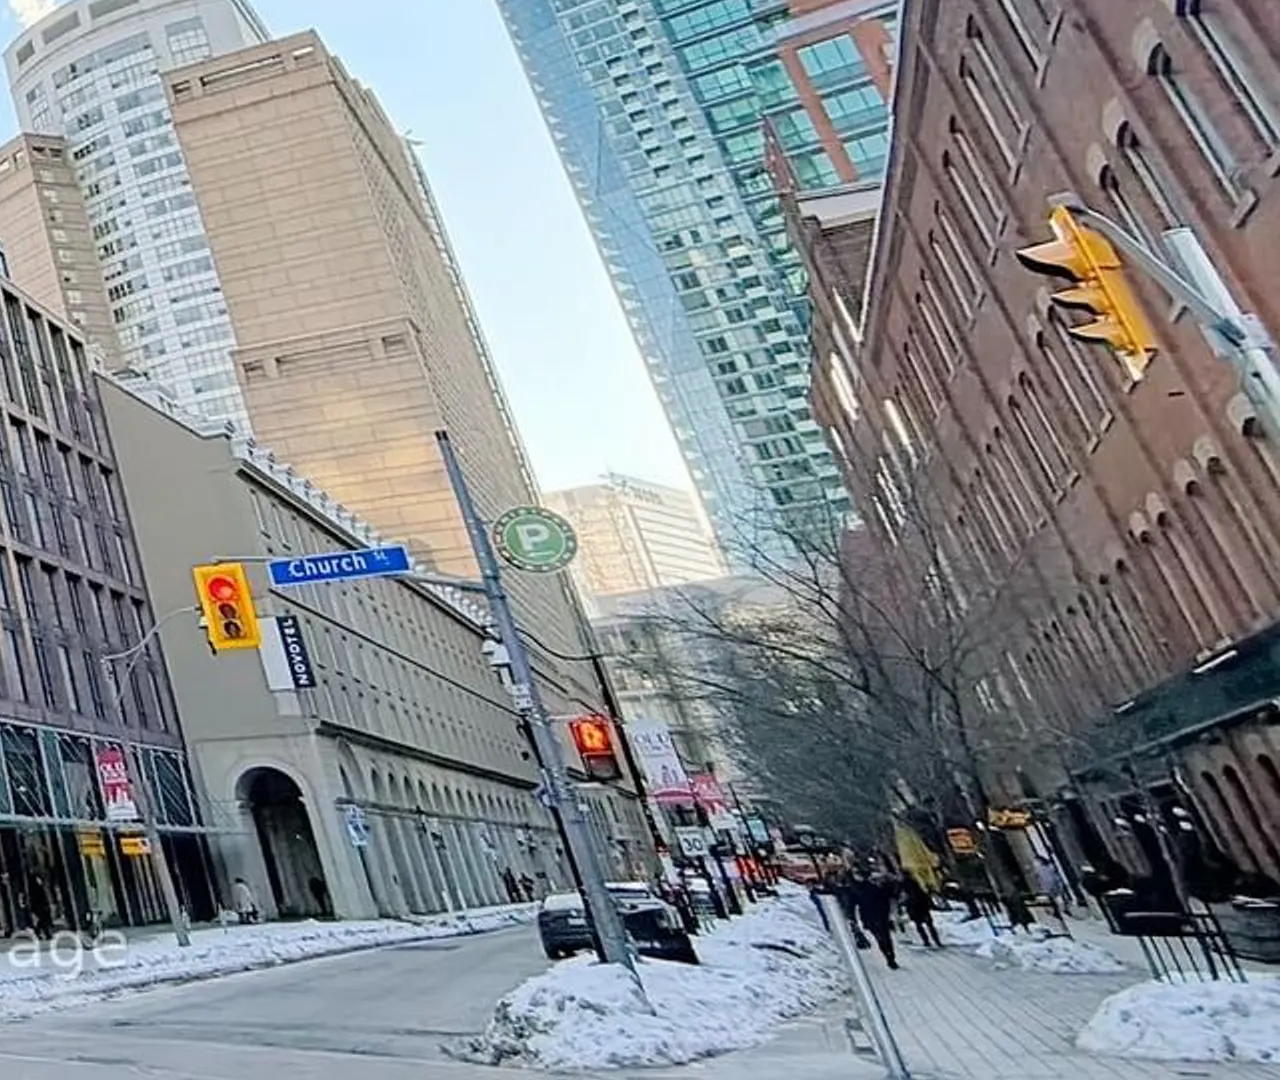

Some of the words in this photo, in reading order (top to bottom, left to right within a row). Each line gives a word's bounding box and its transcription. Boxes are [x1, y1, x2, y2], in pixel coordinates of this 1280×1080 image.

[516, 524, 550, 550] P
[289, 553, 368, 577] Church
[282, 619, 310, 686] NOVOTEL
[682, 837, 703, 851] 30
